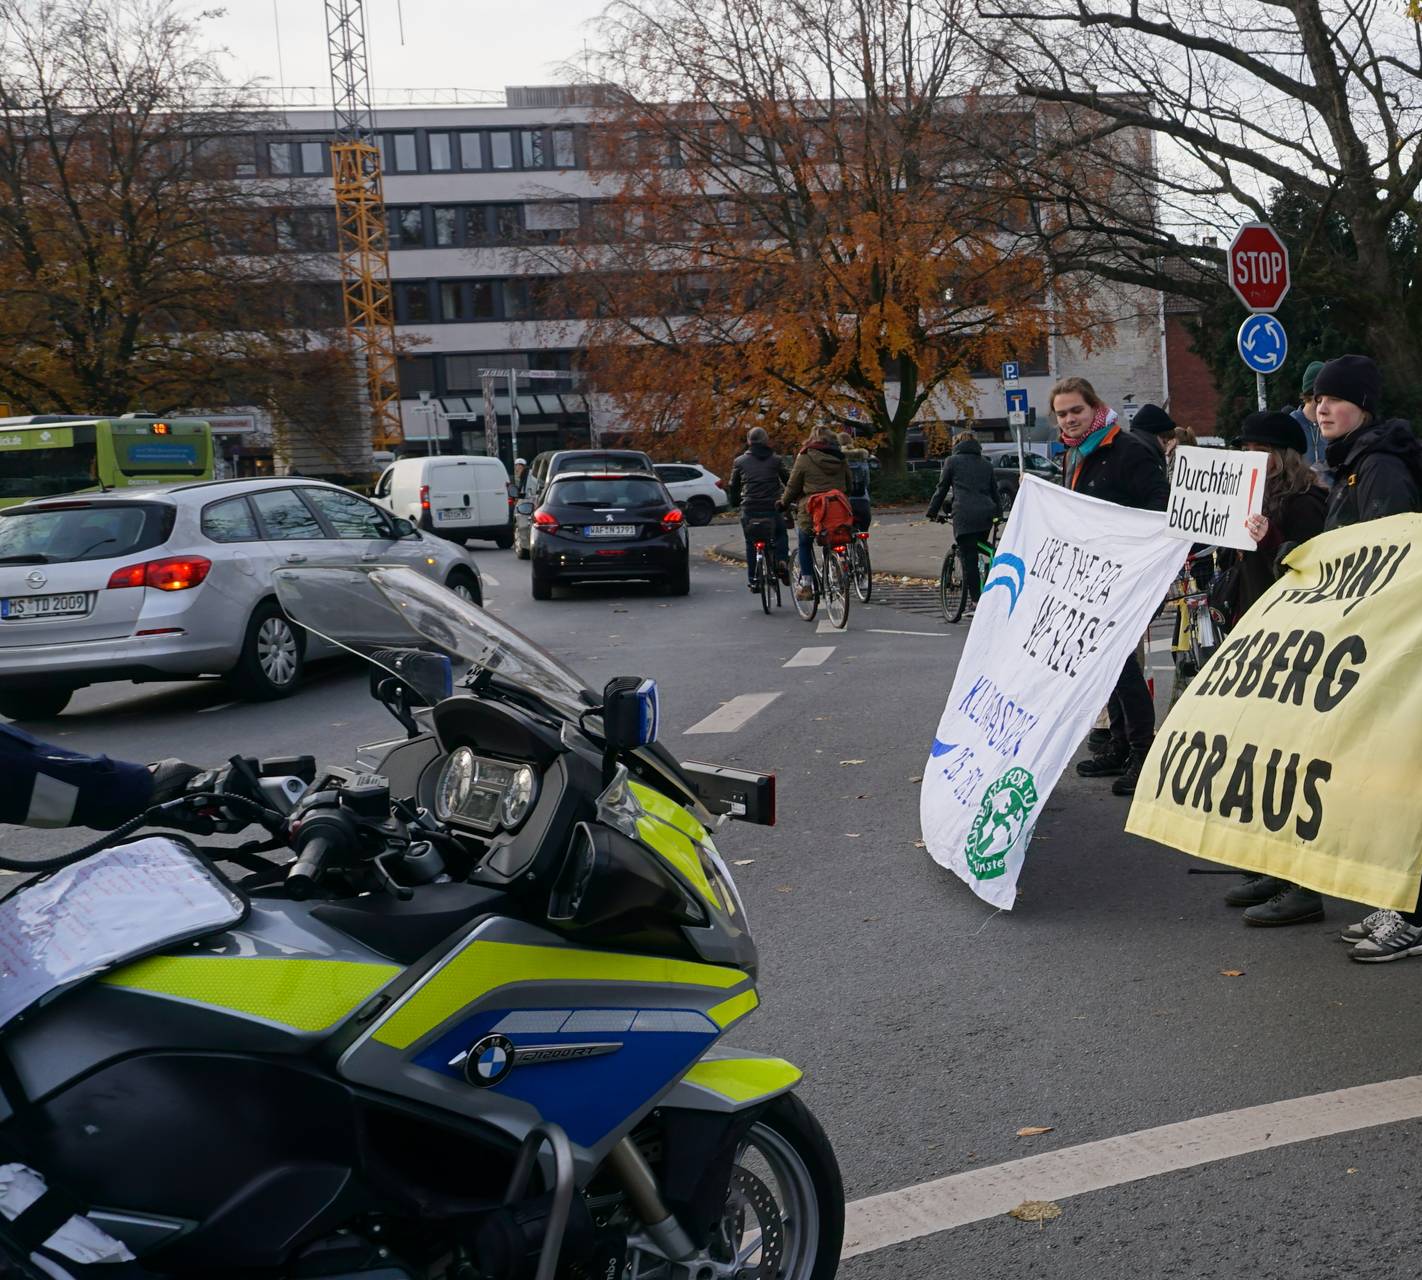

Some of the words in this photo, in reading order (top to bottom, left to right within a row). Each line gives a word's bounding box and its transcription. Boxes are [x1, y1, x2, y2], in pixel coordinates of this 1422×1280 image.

[1236, 250, 1282, 285] STOP
[1176, 455, 1243, 497] Durchfahrt
[1169, 495, 1231, 537] blockiert
[10, 600, 24, 614] MS
[35, 598, 50, 612] TD
[52, 596, 84, 610] 2009
[1196, 629, 1367, 713] EISBERG
[1155, 731, 1332, 842] VORAUS
